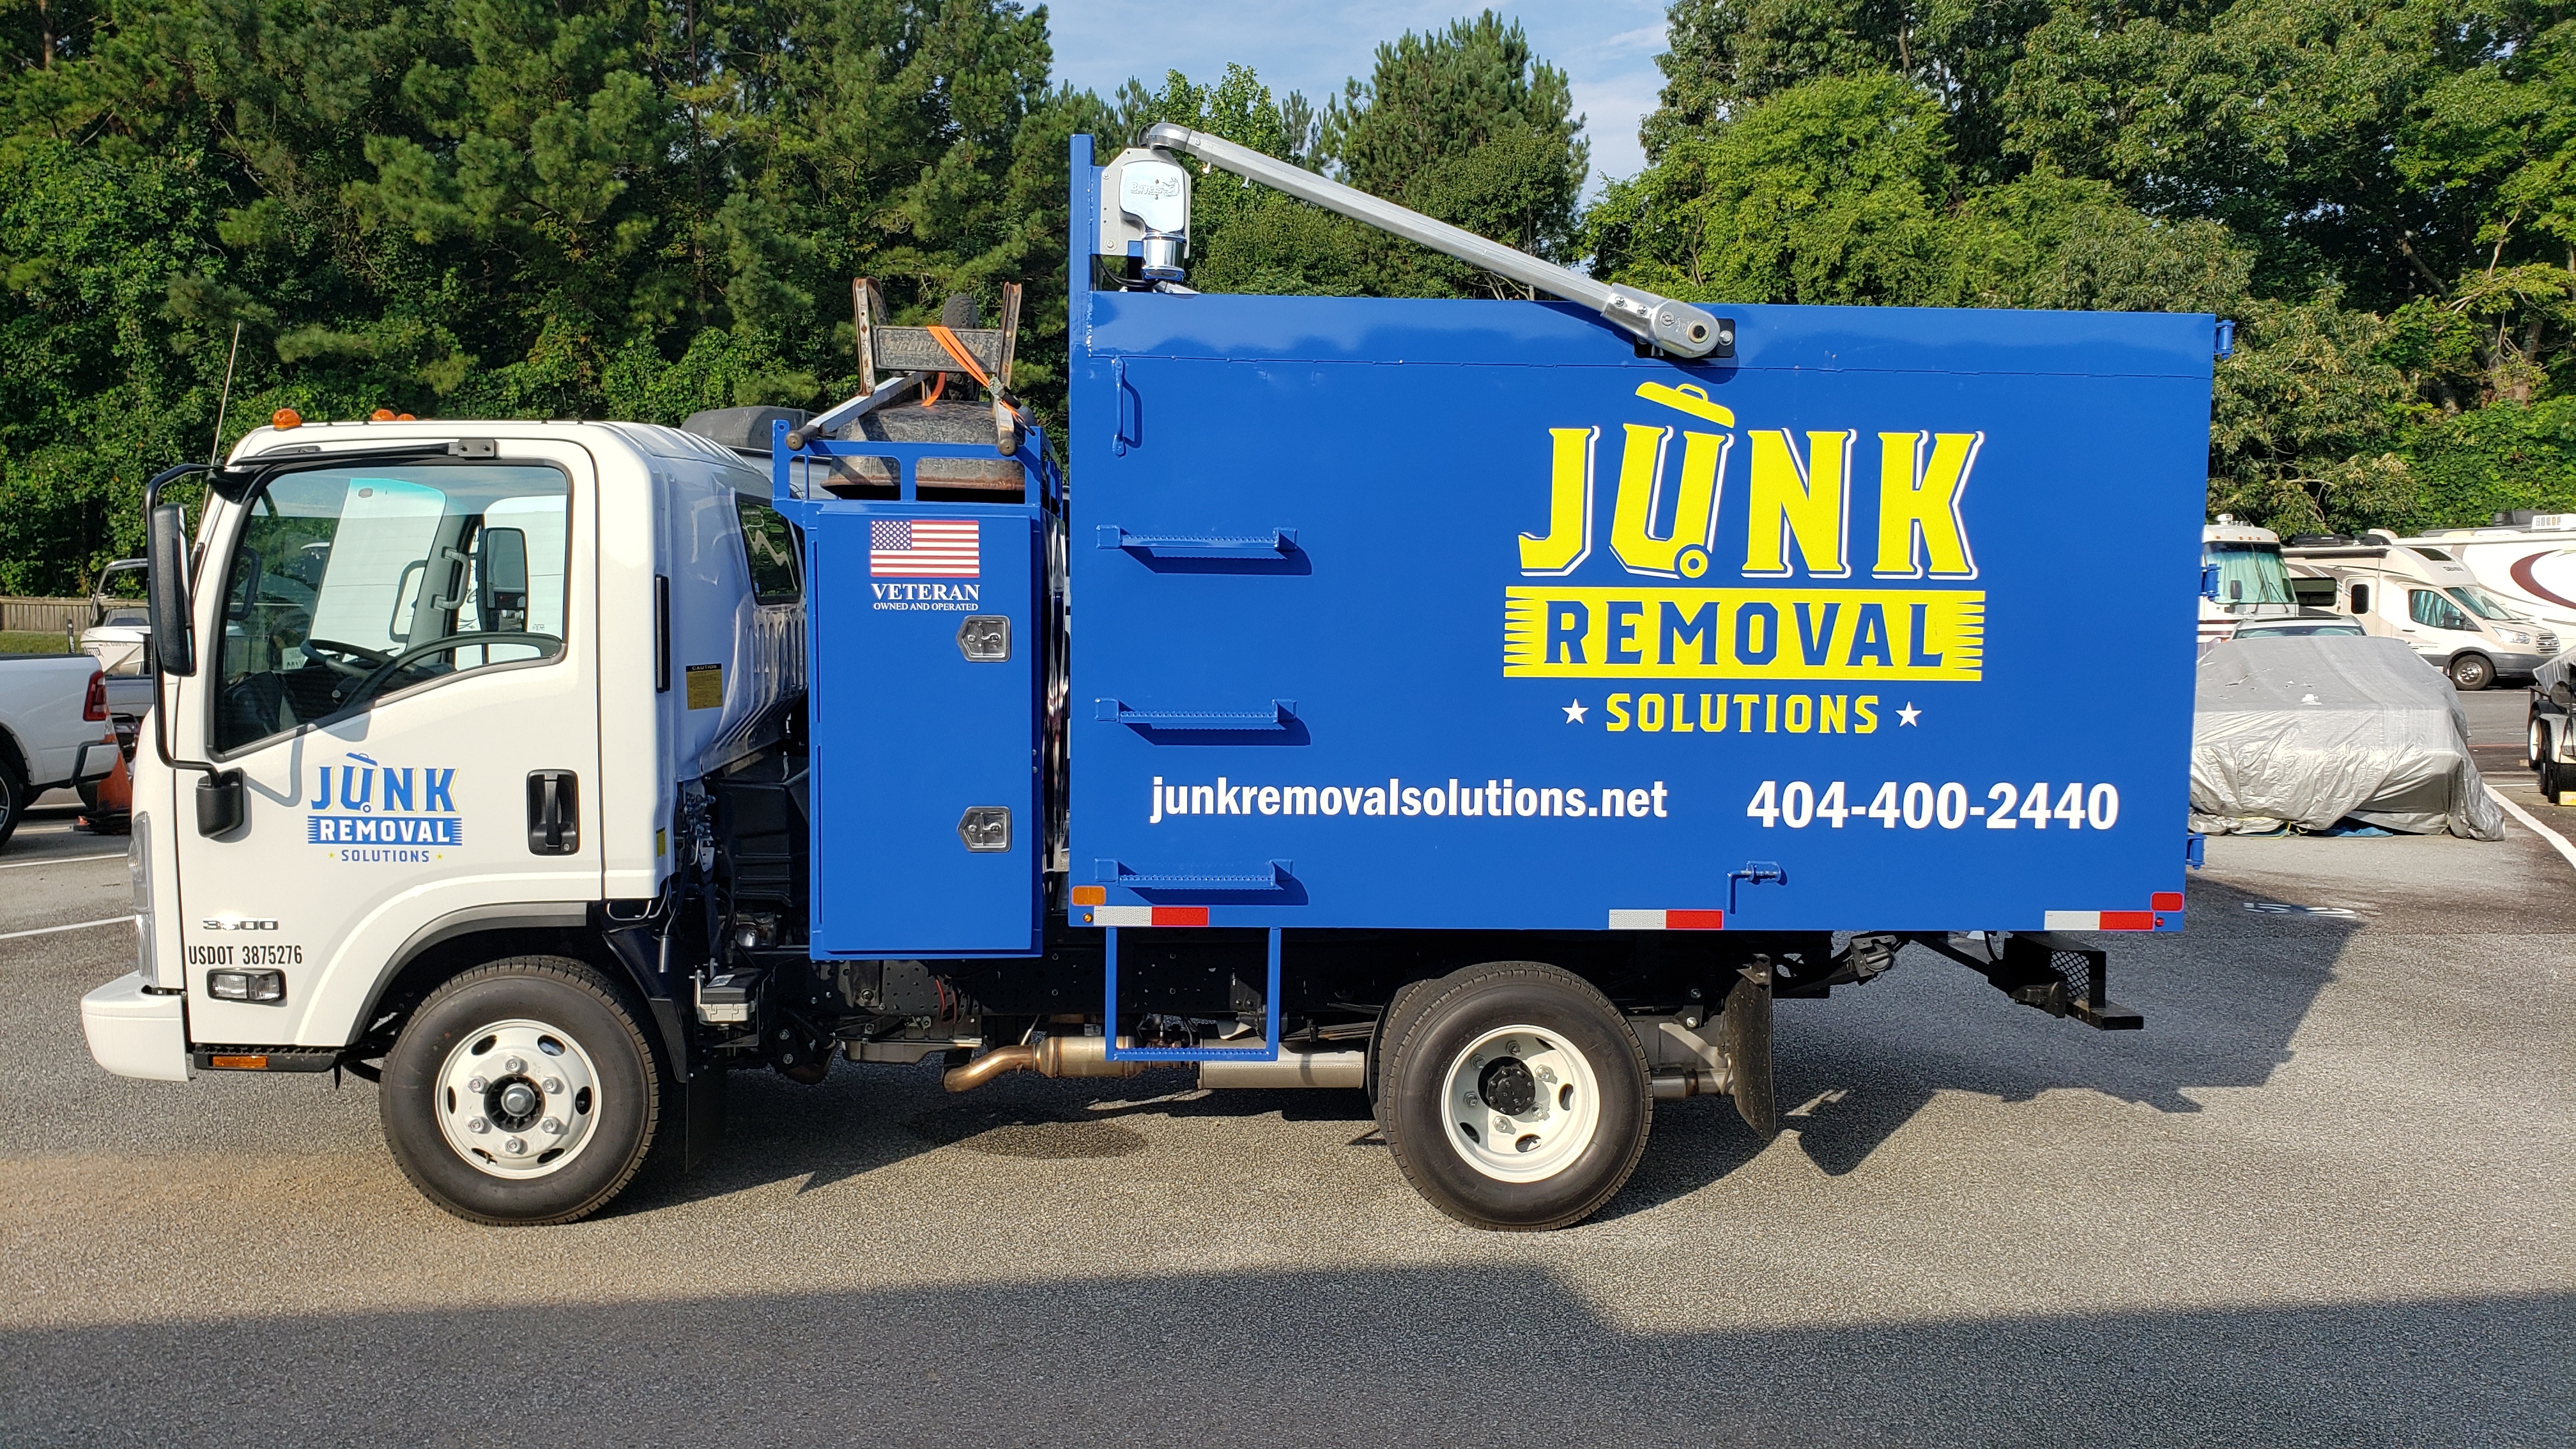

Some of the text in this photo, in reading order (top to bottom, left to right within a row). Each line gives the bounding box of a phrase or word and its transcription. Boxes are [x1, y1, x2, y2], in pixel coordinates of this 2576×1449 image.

[1518, 424, 1984, 580] JUNK
[871, 583, 981, 601] VETERAN
[873, 602, 979, 611] OWNED AND OPERATED
[1544, 600, 1944, 668] REMOVAL
[1606, 693, 1878, 733] SOLUTIONS
[310, 765, 459, 814] JUNK
[1149, 776, 1668, 824] junkremovalsolutions.net
[1747, 779, 2120, 830] 404-400-2440
[319, 819, 450, 843] REMOVAL
[341, 849, 431, 862] SOLUTIONS
[188, 945, 303, 965] USDOT 3875276
